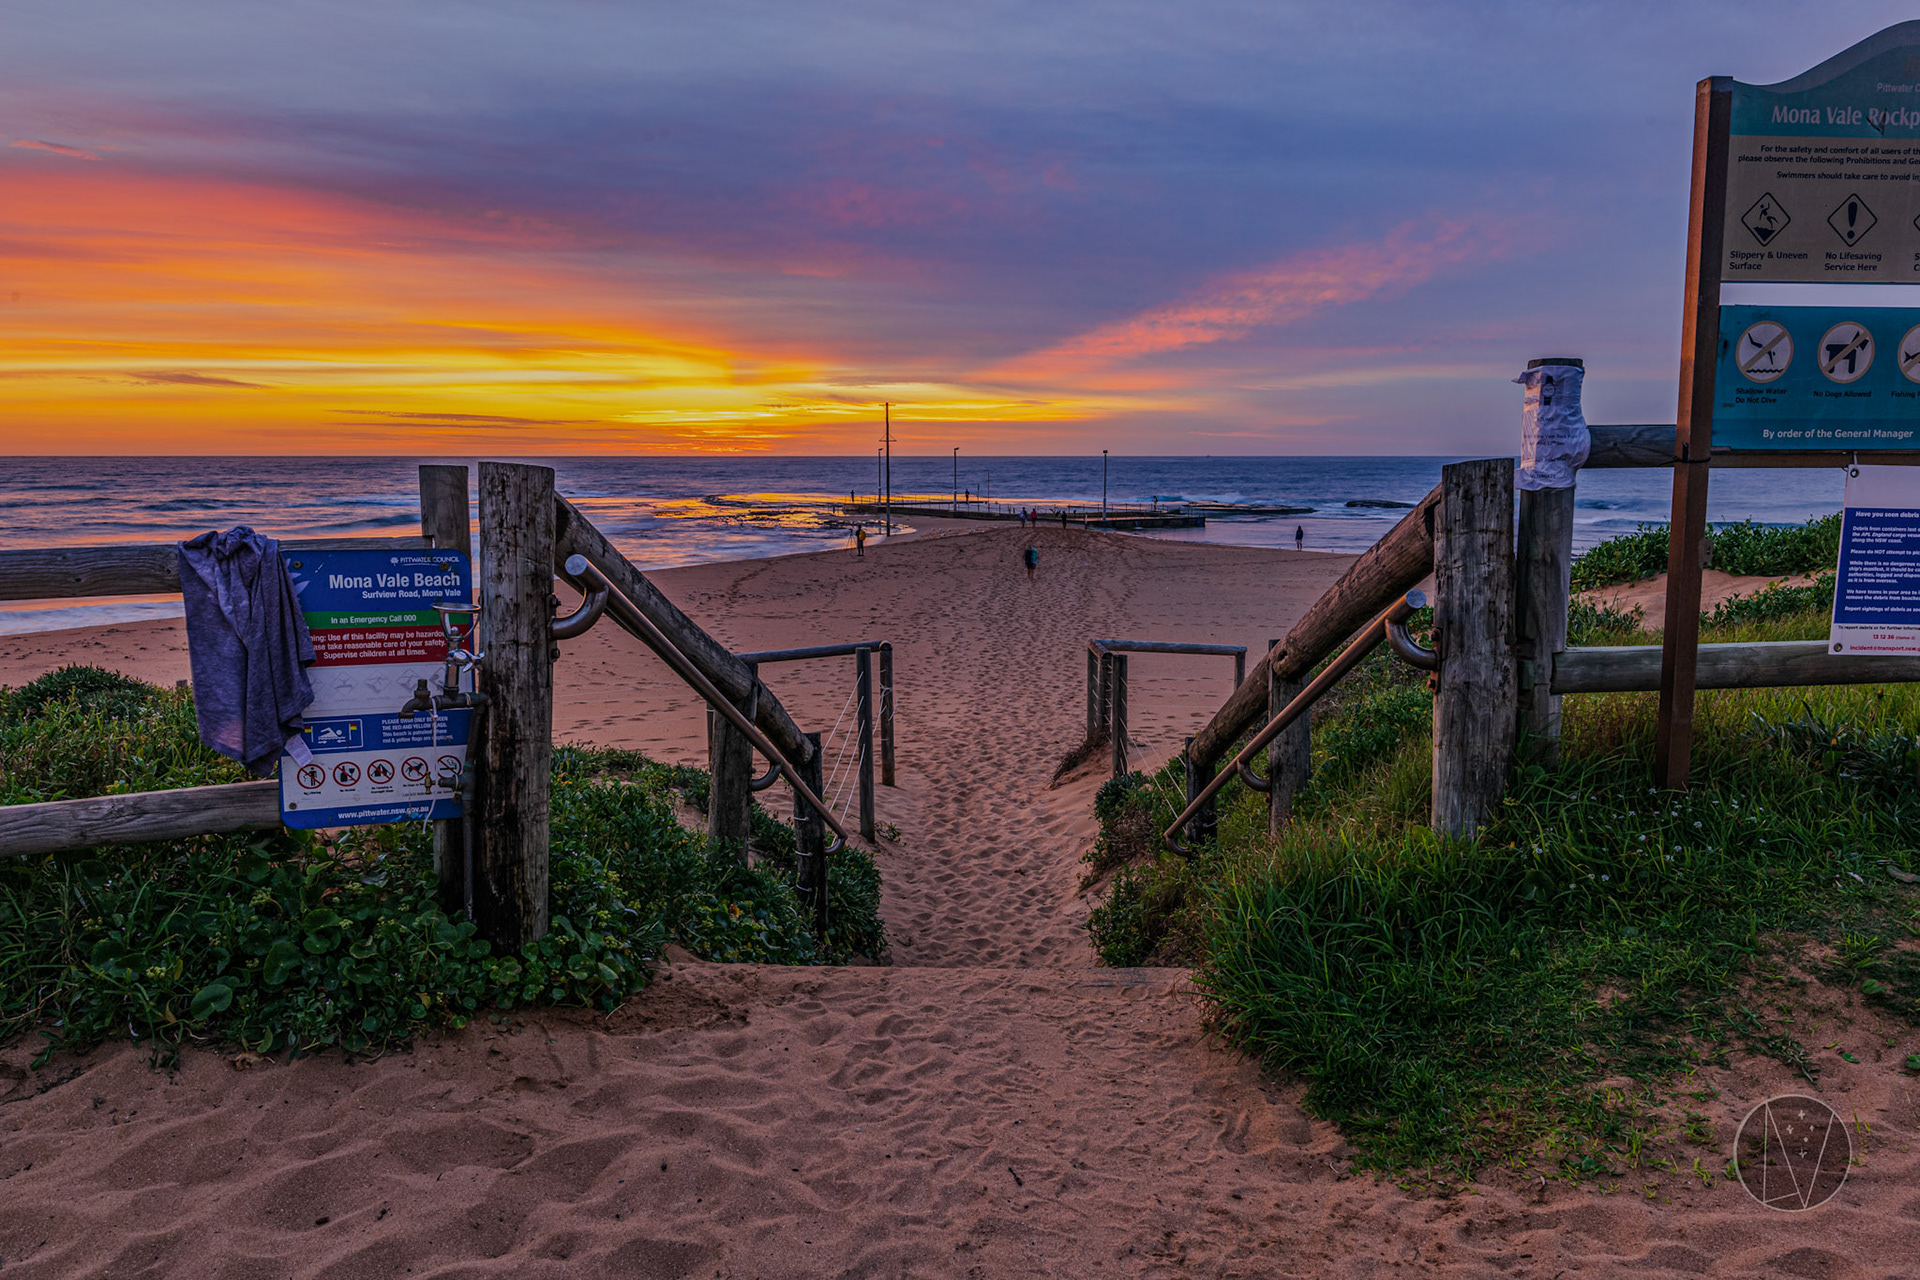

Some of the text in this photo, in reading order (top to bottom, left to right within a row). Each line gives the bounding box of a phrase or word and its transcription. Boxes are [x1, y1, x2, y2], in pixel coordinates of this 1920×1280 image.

[1876, 82, 1913, 93] Pittwater
[1772, 105, 1820, 124] Mona
[1826, 106, 1862, 125] Vale
[1789, 146, 1812, 154] safety
[1738, 154, 1762, 163] please
[1810, 156, 1844, 165] following
[1776, 171, 1816, 179] Swimmers
[1844, 172, 1860, 180] take
[1730, 250, 1765, 260] Slippery
[1840, 252, 1882, 262] Lifesaving
[1891, 391, 1916, 399] Fishing
[1763, 429, 1913, 440] By order of the General Manager
[328, 572, 460, 588] Mona Vale Beach
[399, 590, 420, 598] Road,
[350, 616, 388, 624] Emergency
[366, 632, 388, 641] facility
[390, 633, 404, 641] may
[344, 642, 382, 650] reasonable
[408, 640, 422, 648] your
[424, 639, 446, 647] safety.
[324, 651, 358, 660] Supervise
[338, 806, 430, 820] www.pittwater.nsw.gov.au
